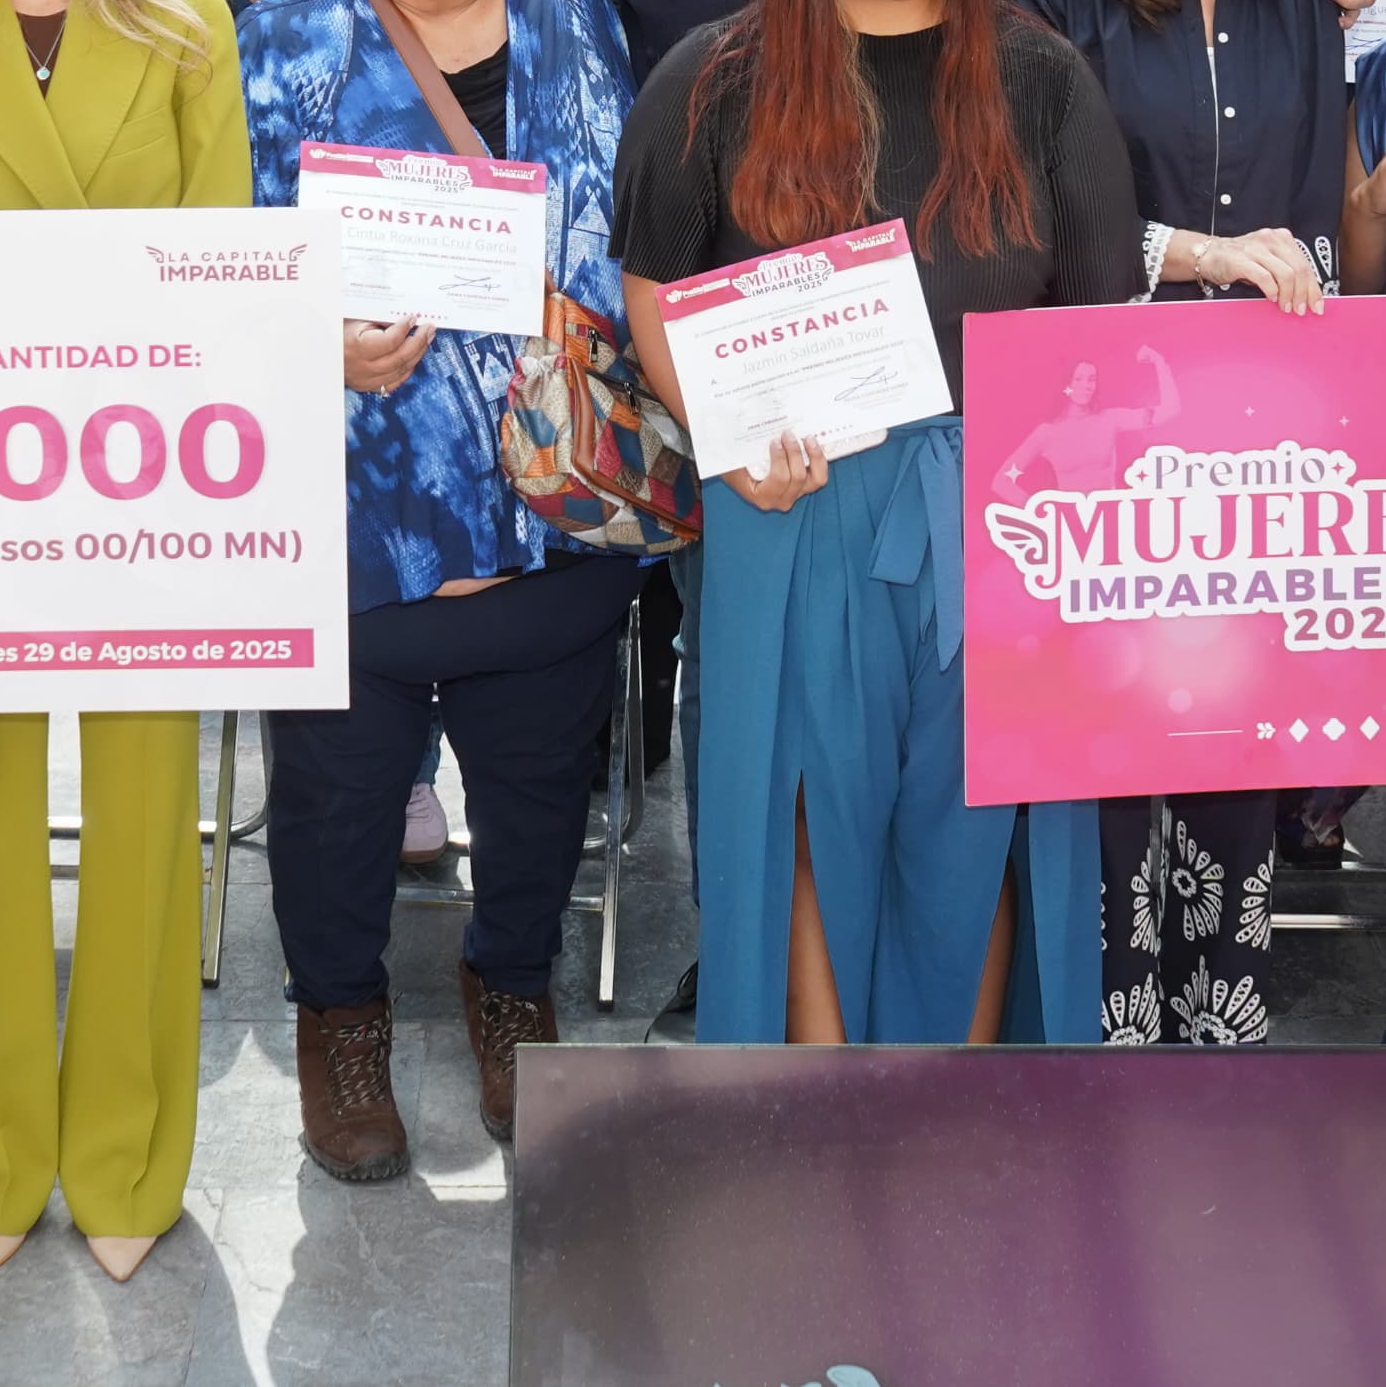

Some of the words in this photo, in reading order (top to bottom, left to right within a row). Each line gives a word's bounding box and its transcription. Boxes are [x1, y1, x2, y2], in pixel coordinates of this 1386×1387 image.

[387, 160, 469, 182] MUJERES
[390, 173, 459, 188] IMPARABLES
[434, 185, 459, 194] 2025
[341, 206, 512, 235] CONSTANCIA
[167, 251, 190, 263] LA
[201, 250, 288, 262] CAPITAL
[159, 263, 300, 282] IMPARABLE
[741, 254, 829, 291] MUJERES
[751, 271, 822, 298] IMPARABLES
[797, 280, 823, 294] 2025
[715, 298, 890, 359] CONSTANCIA
[147, 343, 203, 369] DE:
[1154, 449, 1326, 490] Premio
[74, 528, 214, 565] 00/100
[223, 530, 304, 565] MN)
[24, 640, 56, 664] 29
[59, 640, 93, 663] de
[97, 640, 189, 669] Agosto
[191, 639, 226, 661] de
[229, 638, 293, 661] 2025
